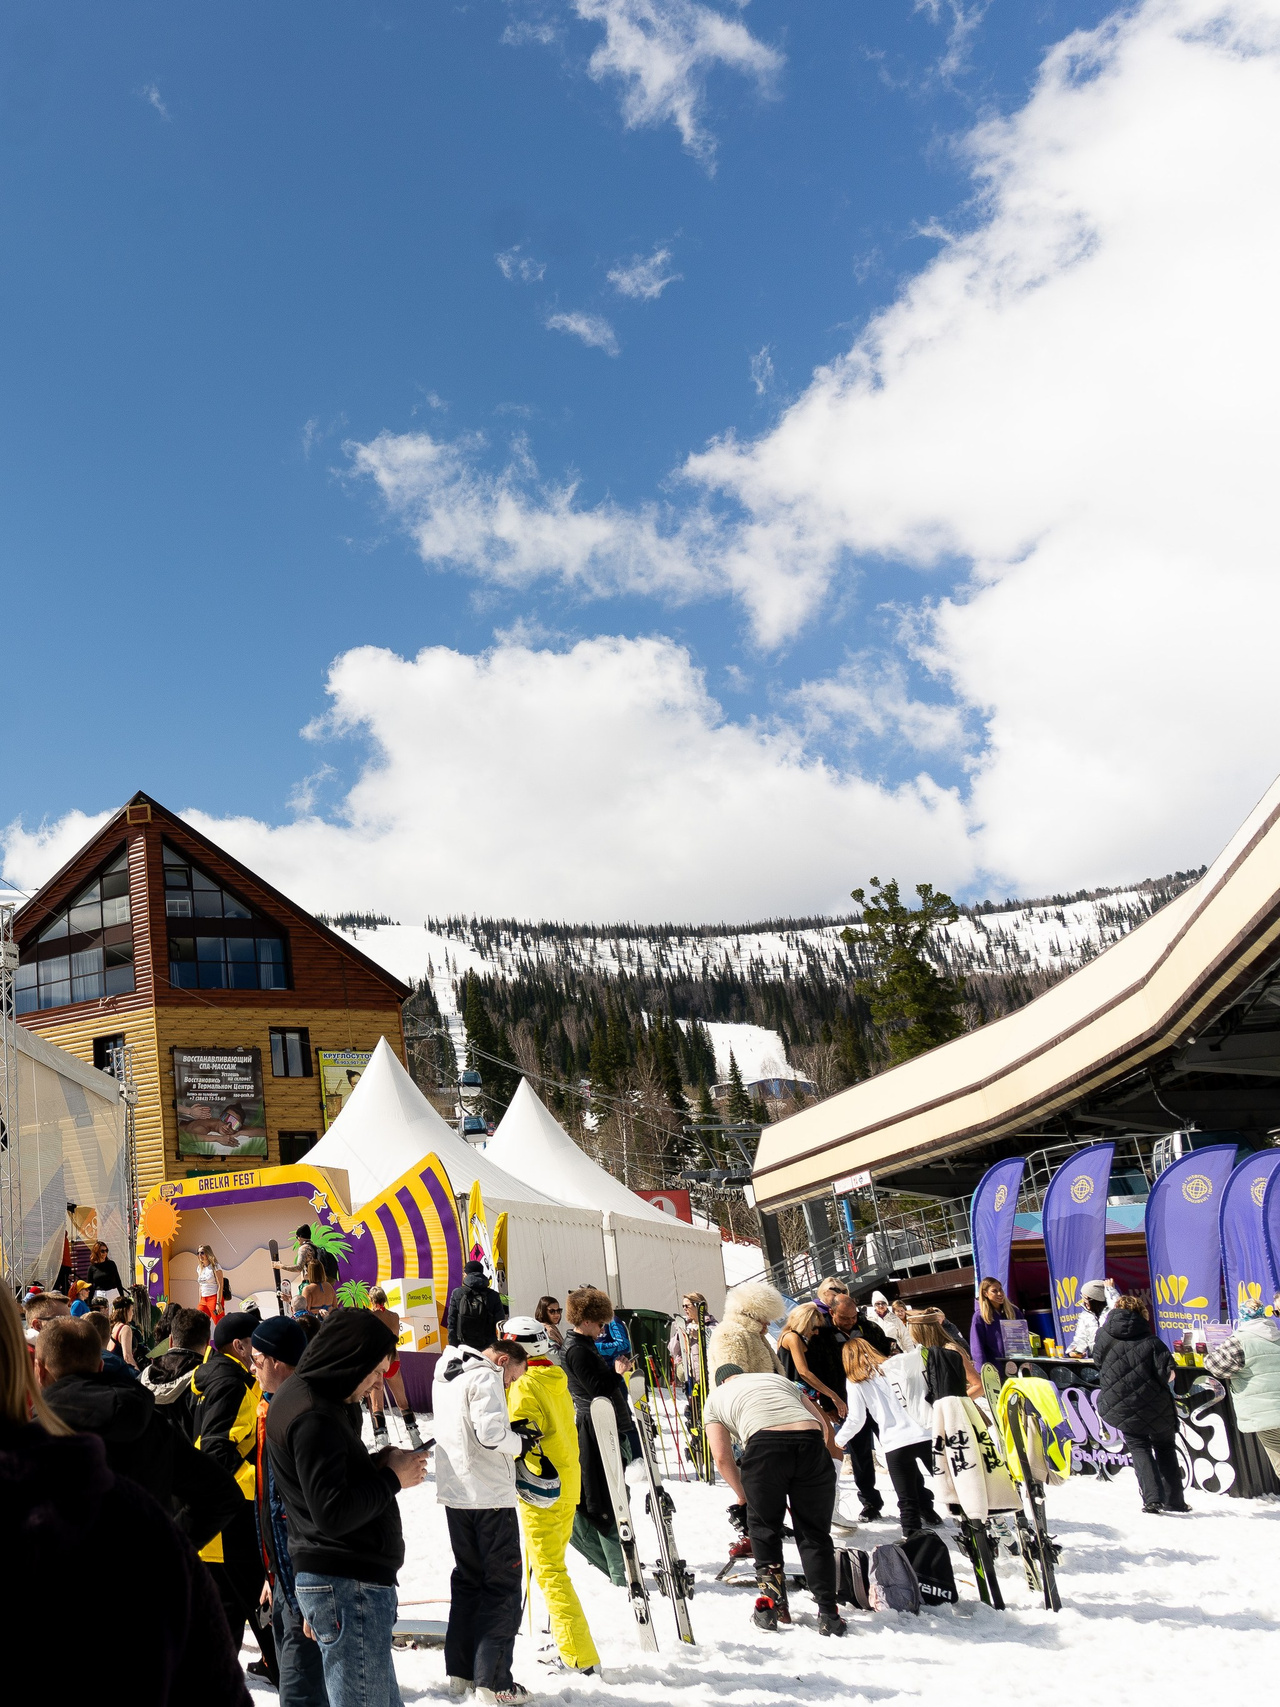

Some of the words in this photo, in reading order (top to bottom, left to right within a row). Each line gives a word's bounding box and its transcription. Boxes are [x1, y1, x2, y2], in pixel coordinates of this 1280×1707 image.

[182, 1055, 252, 1063] ВОССТАНАВЛИВАЮЩИЙ
[198, 1082, 233, 1090] Термальном
[198, 1175, 230, 1191] GRELKA
[233, 1172, 255, 1187] FEST
